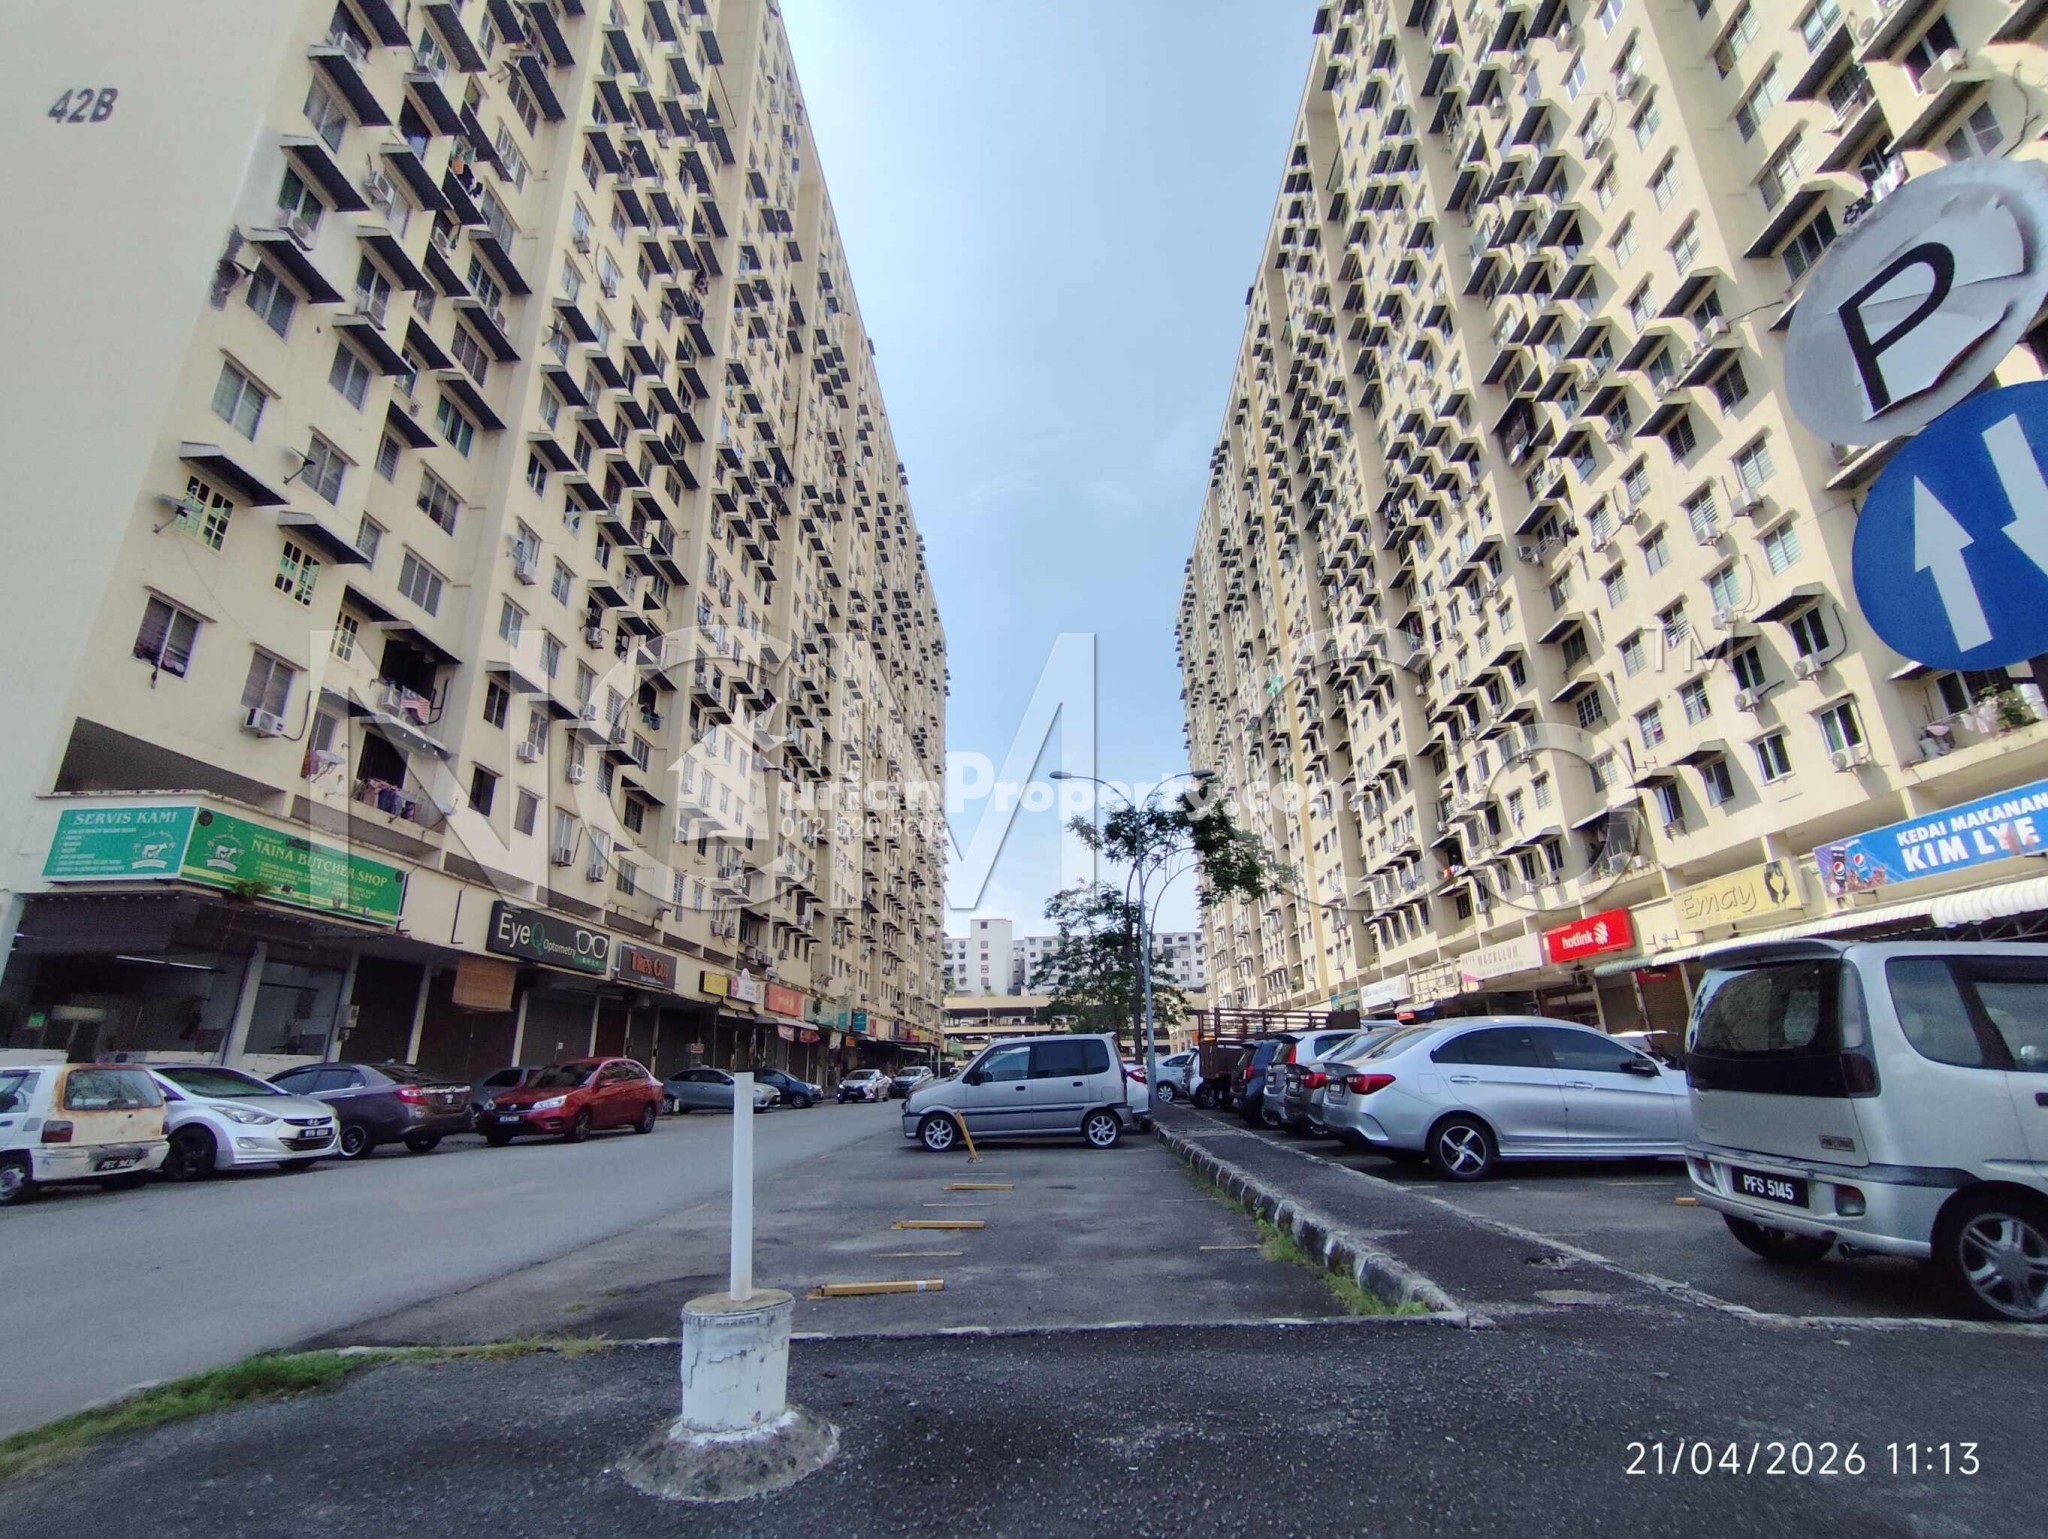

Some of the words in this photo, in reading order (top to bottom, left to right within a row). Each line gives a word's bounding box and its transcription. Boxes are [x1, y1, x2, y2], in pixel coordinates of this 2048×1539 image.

[48, 87, 119, 124] 42B
[1838, 241, 1955, 422] P
[73, 811, 132, 826] SERVIS
[136, 811, 178, 824] KAMI
[1896, 820, 1946, 847] KEDAI
[1949, 791, 2048, 832] MAKANAN
[251, 839, 294, 863] NAINA
[298, 854, 355, 881] BUTCHER
[358, 870, 388, 888] SHOP
[1901, 835, 1970, 873] KIM
[1971, 816, 2041, 856] LYE
[1681, 881, 1757, 921] Emay
[543, 940, 577, 959] Optometry
[1561, 929, 1594, 950] hotlink
[1743, 1174, 1765, 1194] PFS
[1766, 1178, 1794, 1201] 5145
